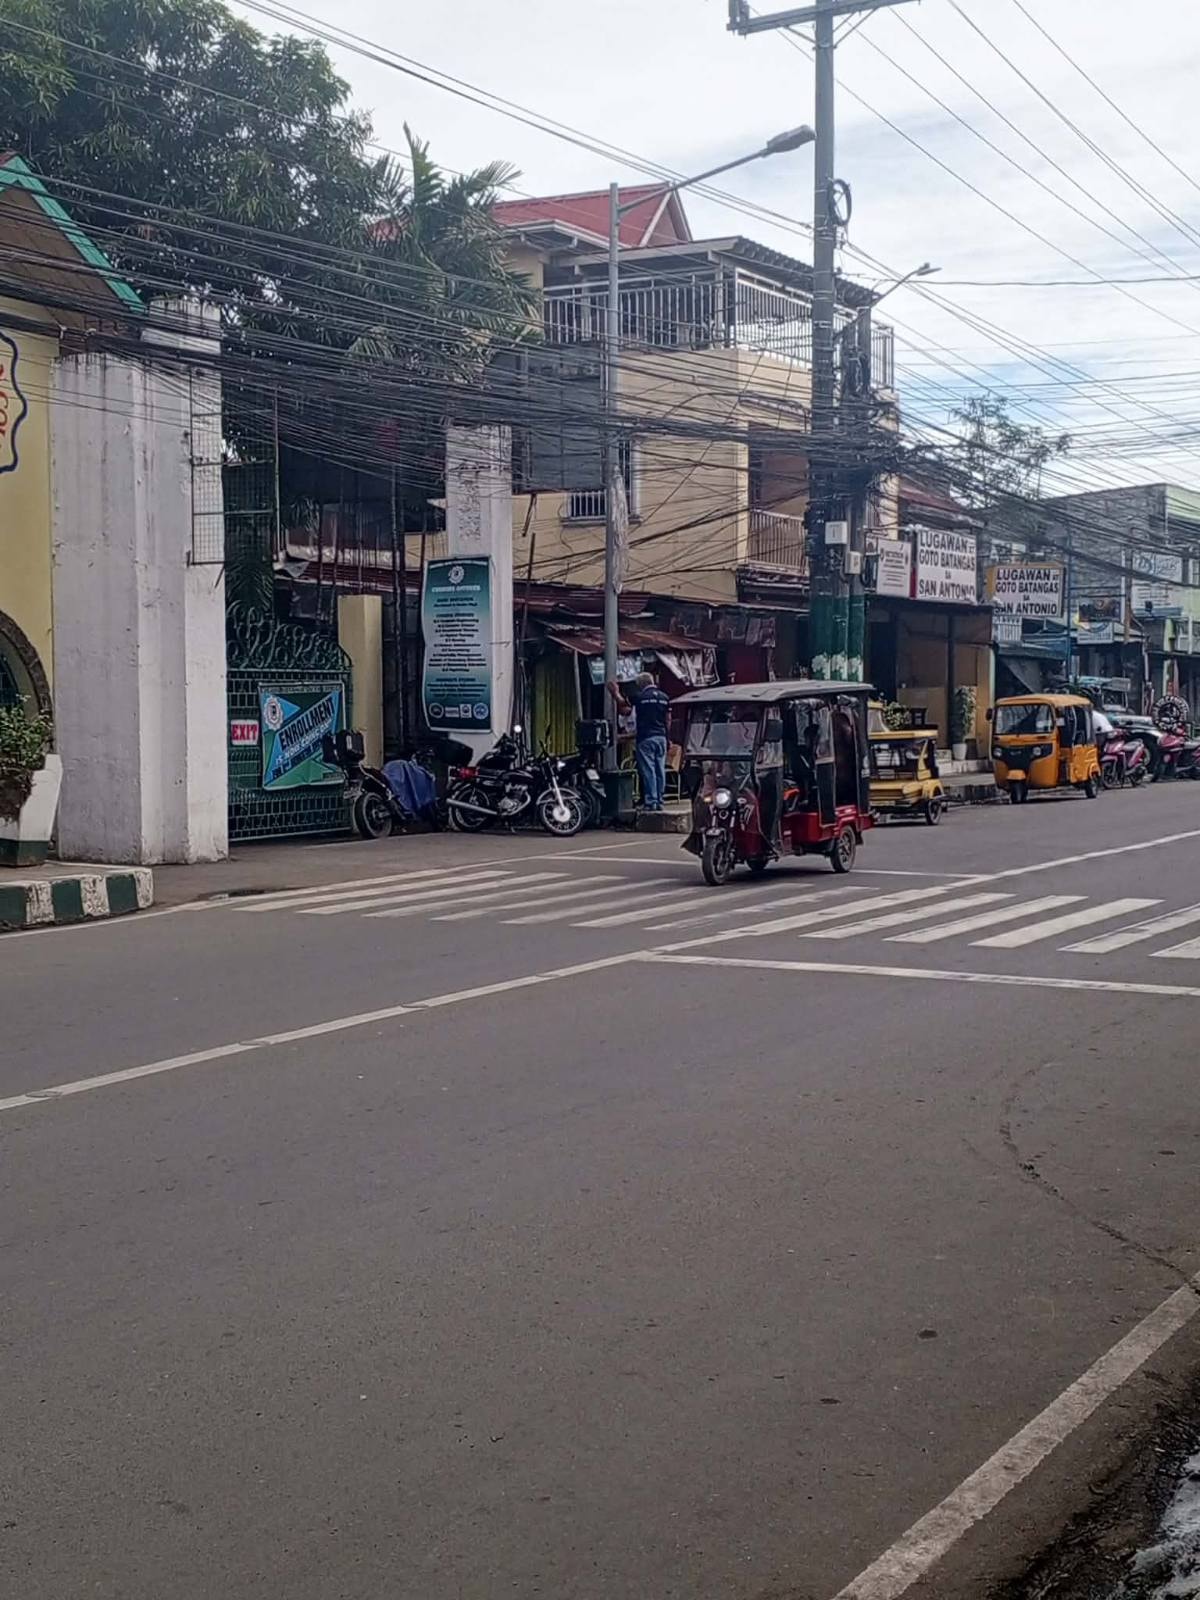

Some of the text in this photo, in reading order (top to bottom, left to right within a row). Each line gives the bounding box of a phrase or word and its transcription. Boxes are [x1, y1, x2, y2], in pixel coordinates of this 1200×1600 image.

[919, 530, 969, 551] LUGAWAN
[919, 548, 975, 571] GOTO BATANGAS
[996, 567, 1051, 580] LUGAWAN
[919, 579, 937, 596] SAN
[995, 581, 1059, 594] GOTO BATANGAS
[1016, 603, 1057, 614] ANTONIO
[231, 724, 258, 741] EXIT
[278, 697, 336, 751] ENROLLMENT
